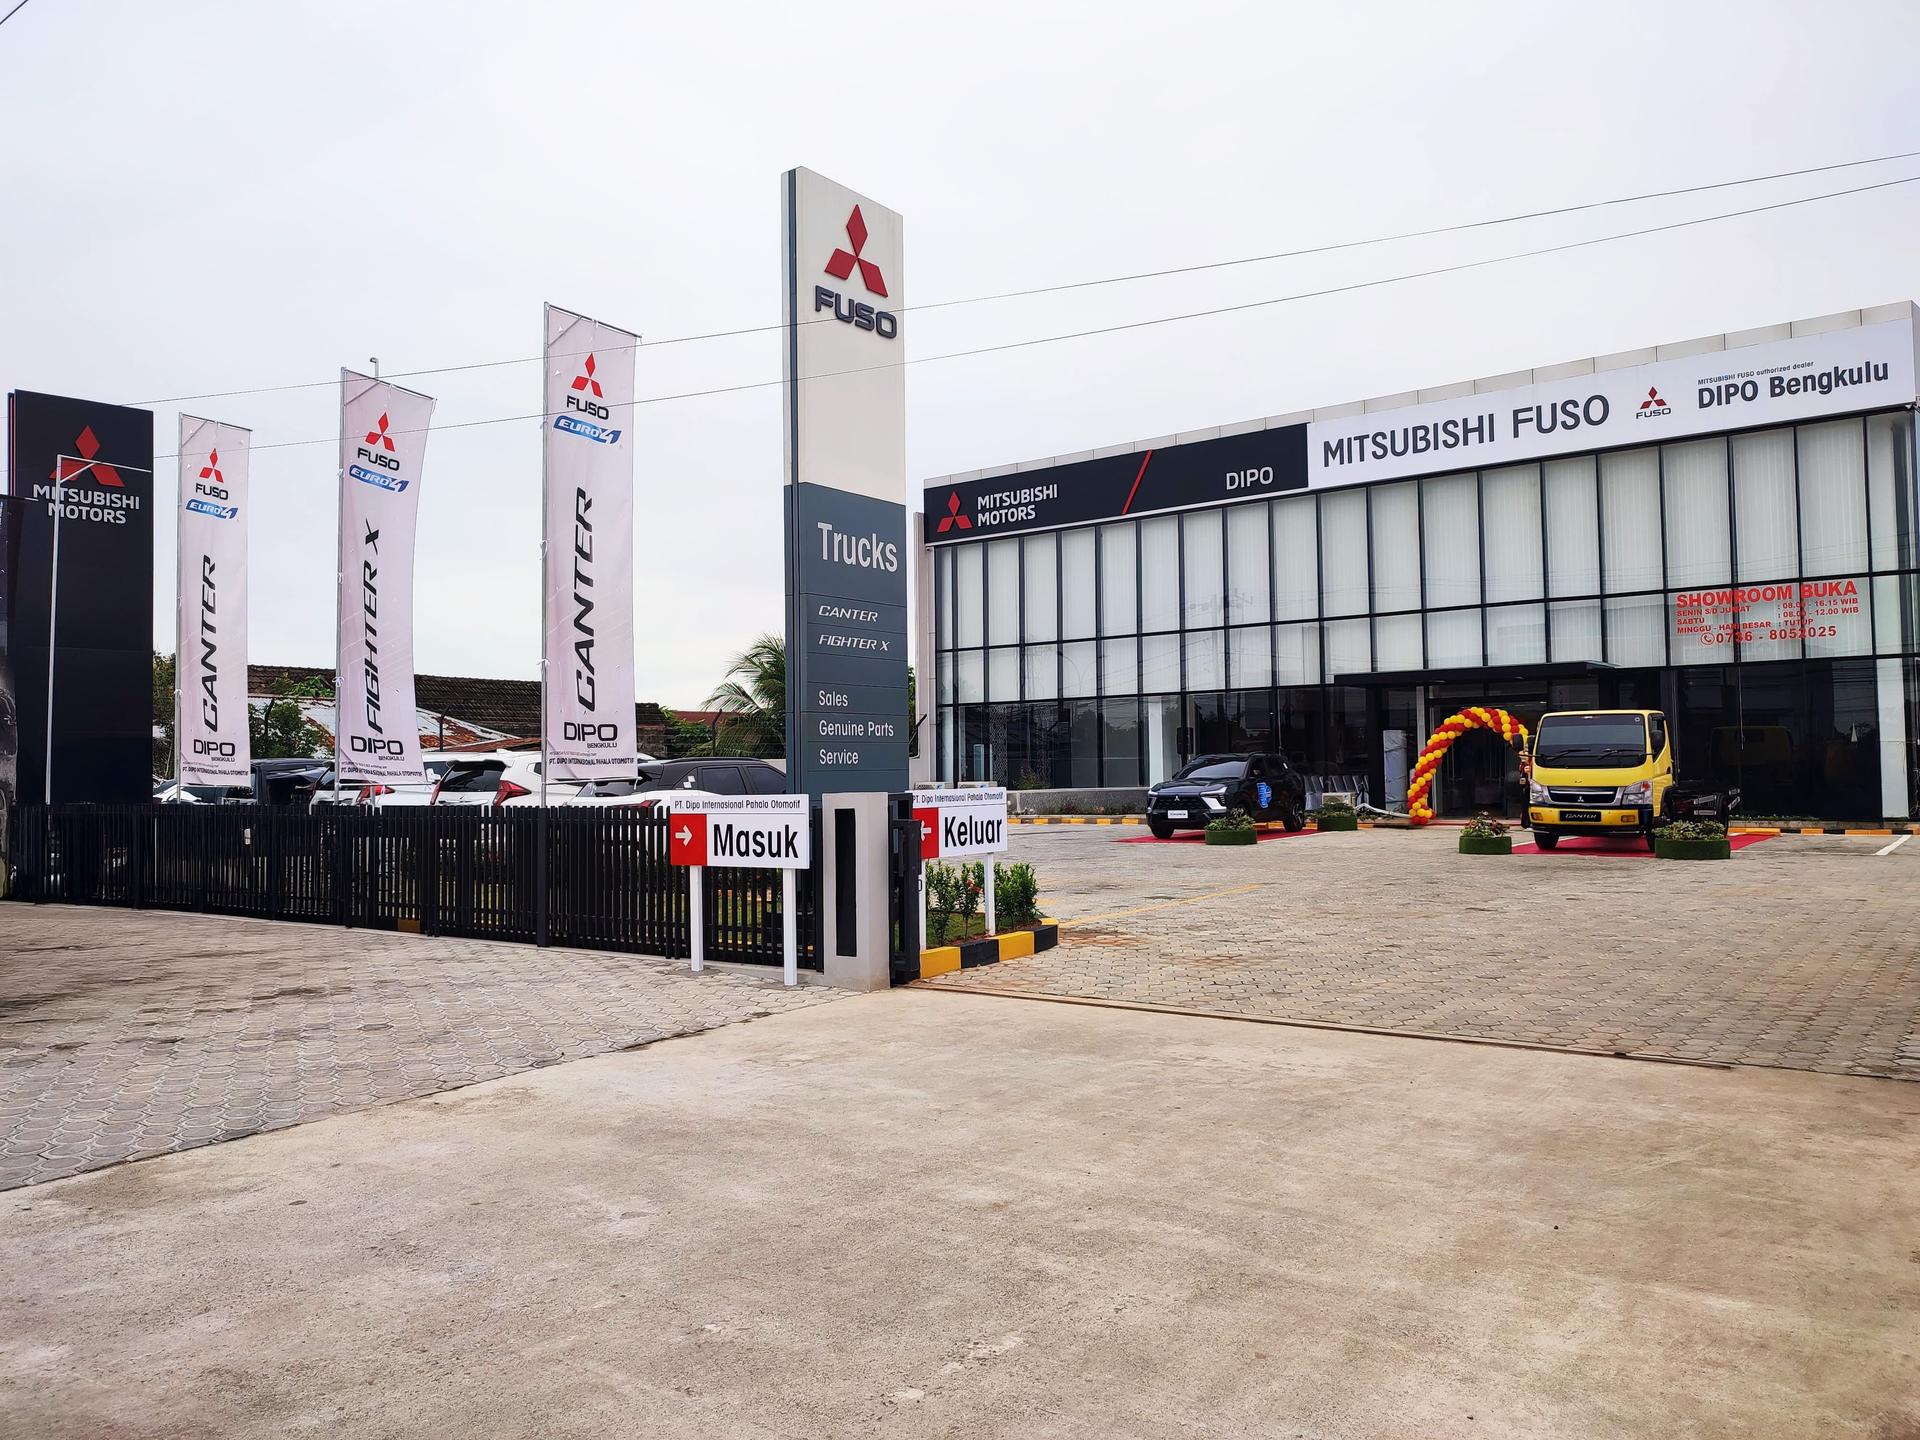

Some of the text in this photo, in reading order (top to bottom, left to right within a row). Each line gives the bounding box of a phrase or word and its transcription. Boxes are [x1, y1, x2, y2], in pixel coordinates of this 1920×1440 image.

[815, 285, 897, 340] FUSO
[1698, 361, 1814, 386] MITSUBISHI FUSO authorized dealer
[1698, 361, 1888, 409] DIPO Bengkulu
[567, 395, 609, 420] FUSO
[1635, 407, 1672, 420] FUSO
[1323, 394, 1610, 468] MITSUBISHI FUSO
[357, 447, 400, 471] FUSO
[1226, 466, 1274, 490] DIPO
[33, 484, 140, 510] MITSUBISHI
[195, 483, 229, 500] FUSO
[977, 484, 1058, 510] MITSUBISHI
[48, 502, 127, 524] MOTORS
[978, 505, 1036, 527] MOTORS
[817, 522, 898, 573] Trucks
[573, 487, 596, 712] CANTER
[1676, 580, 1858, 609] SHOWROOM BUKA
[818, 605, 879, 623] CANTER
[1677, 608, 1703, 617] SENIN
[1677, 617, 1705, 626] SABTU
[1815, 608, 1839, 616] 12.00
[363, 518, 383, 734] FIGHTER X
[1677, 625, 1712, 635] MINGGU
[1742, 621, 1772, 630] BESAR
[201, 554, 218, 732] CANTER
[819, 634, 890, 651] FIGHTER X
[818, 690, 849, 707] Sales
[564, 722, 618, 741] DIPO
[819, 720, 894, 737] Genuine Parts
[193, 738, 236, 756] DIPO
[351, 735, 404, 755] DIPO
[819, 749, 859, 765] Service
[674, 799, 801, 811] PT. Dipo Internasional Pahala Otomotif
[713, 823, 799, 859] Masuk
[944, 815, 1002, 848] Keluar
